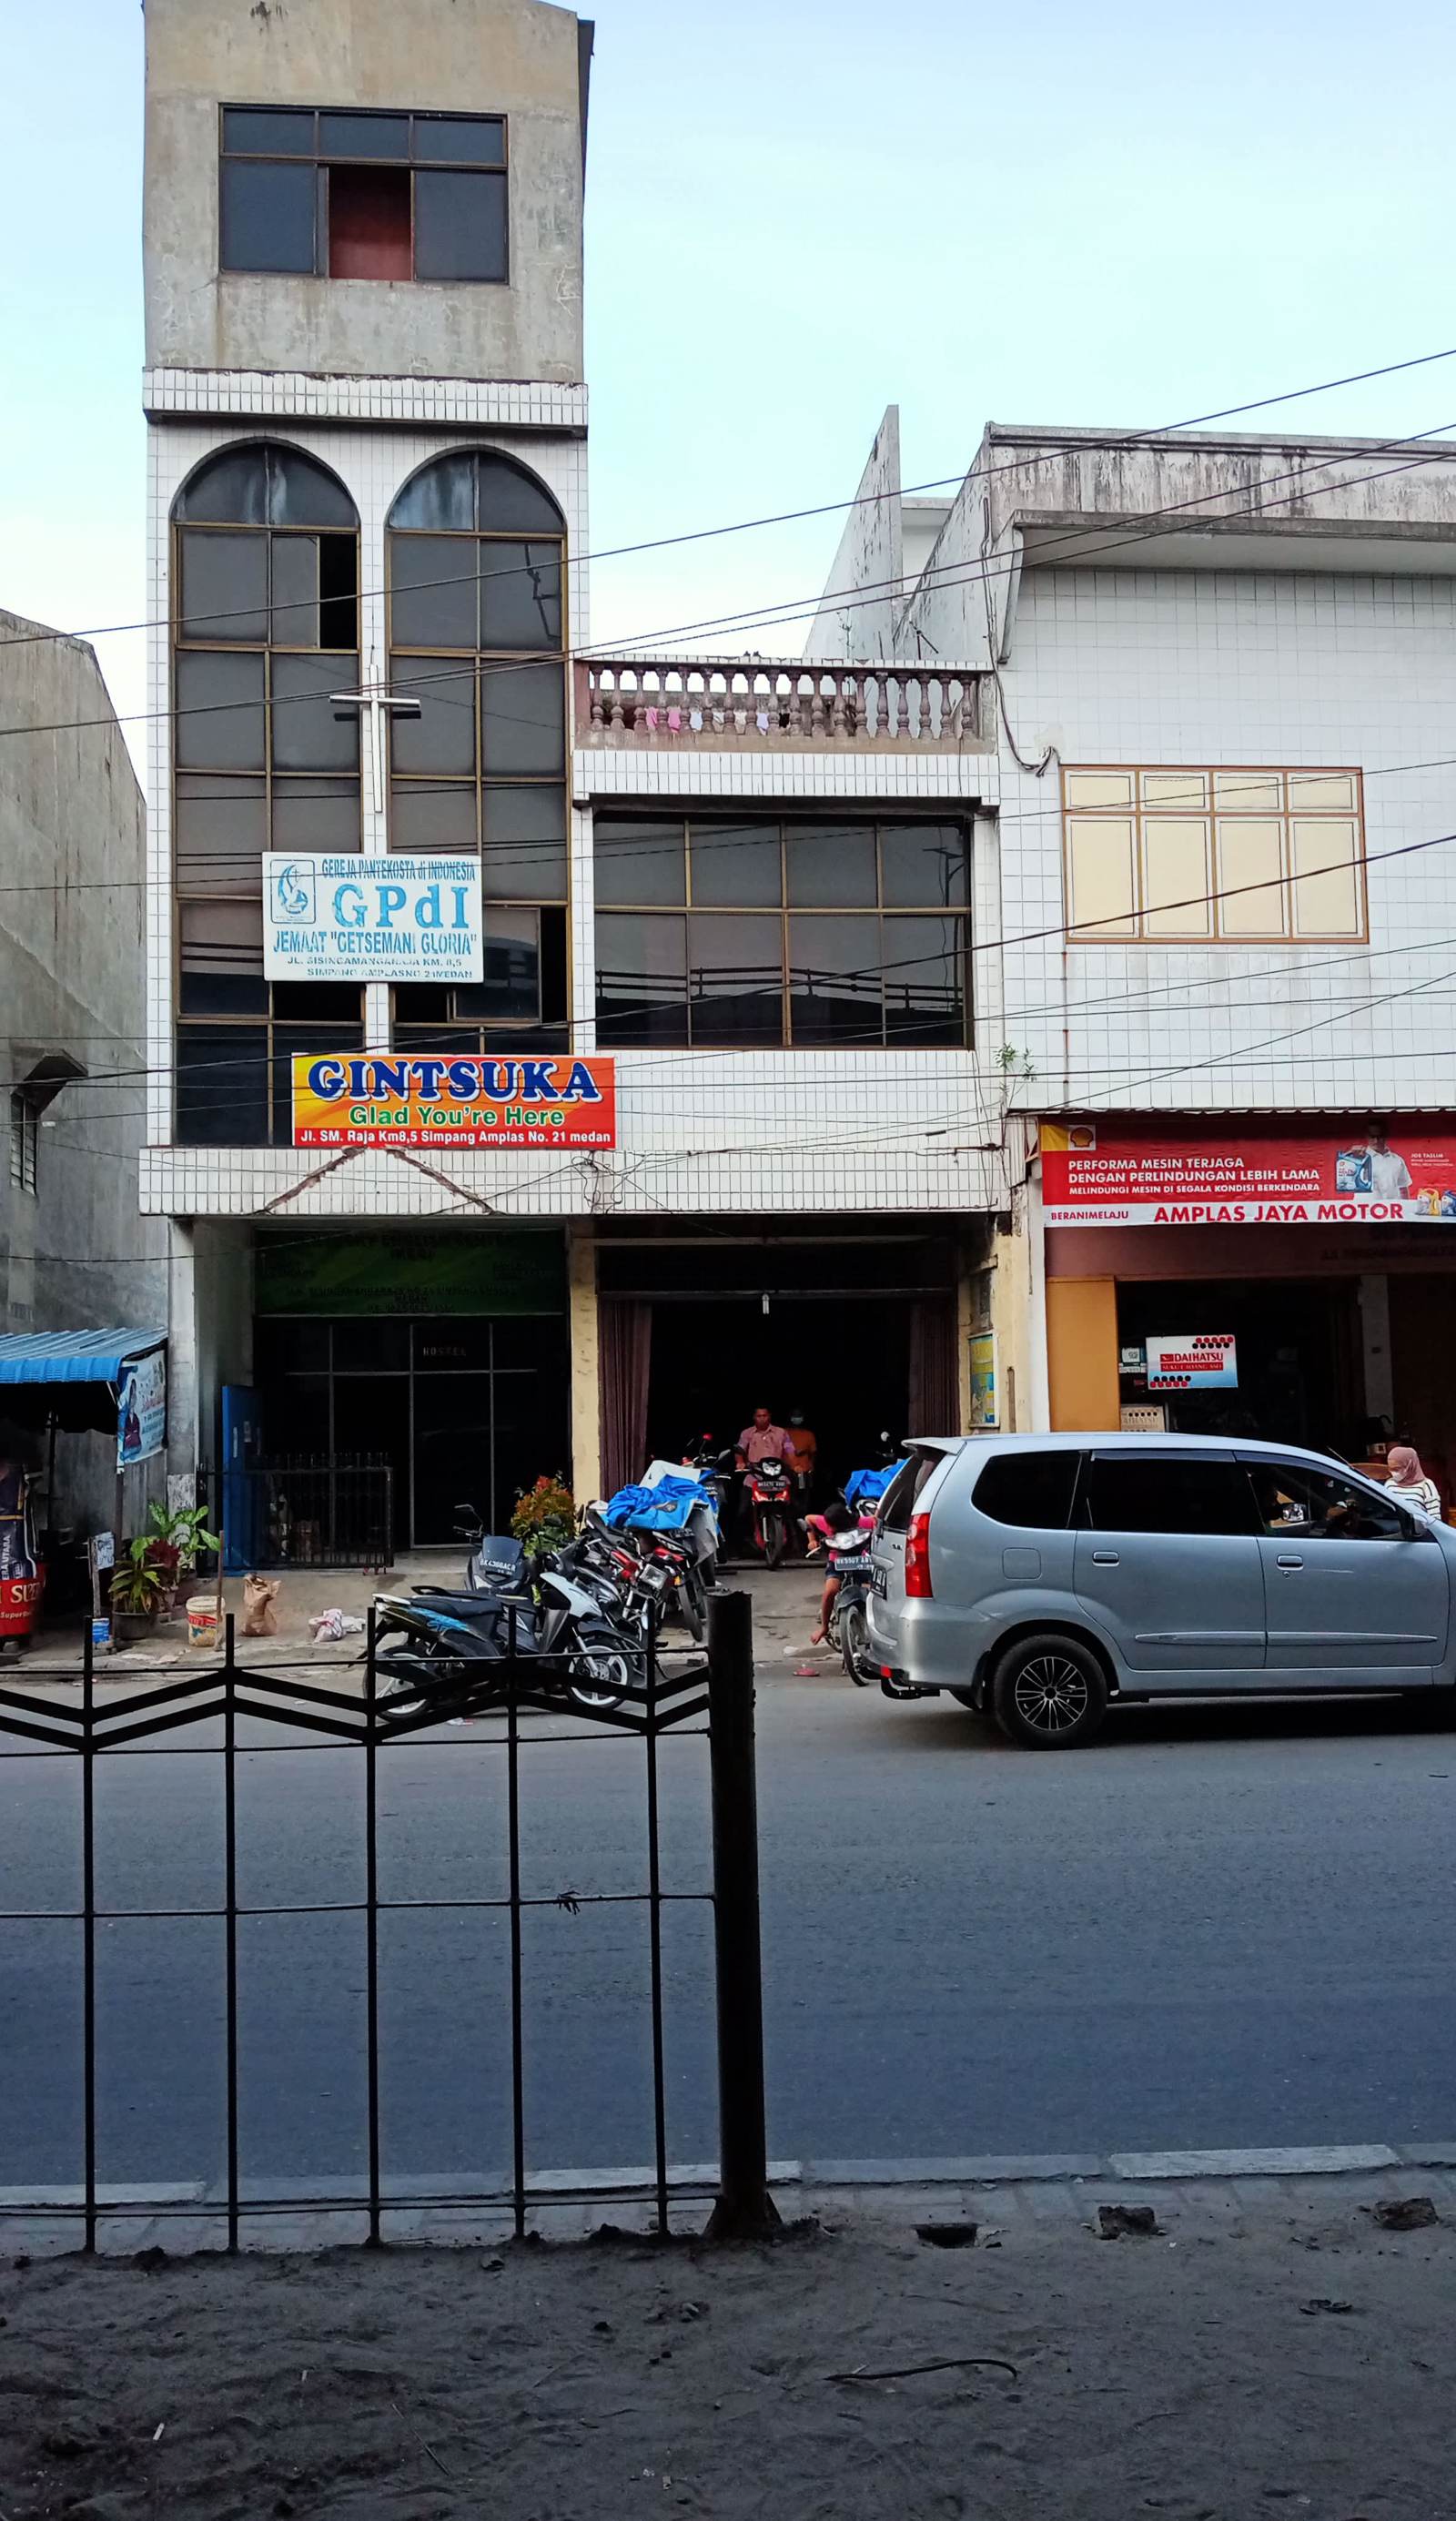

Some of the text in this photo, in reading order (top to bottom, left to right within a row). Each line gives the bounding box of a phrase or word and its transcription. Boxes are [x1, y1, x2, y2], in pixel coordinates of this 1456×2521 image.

[322, 858, 476, 882] GEREJA PANTEKOSTA di INDONESIA
[334, 883, 470, 928] GPdI
[273, 931, 327, 953] JEMAAT
[288, 957, 304, 965] JL.
[308, 1059, 603, 1102] GINTSUKA
[349, 1105, 565, 1126] Glad You're Here
[320, 1129, 343, 1141] SM.
[348, 1130, 376, 1144] Raja
[379, 1130, 418, 1144] Km8,5
[421, 1130, 475, 1144] Simpang
[479, 1130, 524, 1144] Amplas
[528, 1130, 548, 1142] No.
[552, 1130, 566, 1142] 21
[570, 1131, 611, 1143] medan
[1068, 1158, 1245, 1170] PERFORMA MESIN TERJAGA
[1068, 1169, 1320, 1184] DENGAN PERLINDUNGAN LEBIH LAMA
[1069, 1186, 1129, 1195] MELINDUNGI
[1131, 1186, 1161, 1194] MESIN
[1176, 1184, 1212, 1193] SEGALA
[1214, 1184, 1255, 1192] KONDISI
[1257, 1183, 1320, 1192] BERKENDARA
[1050, 1210, 1128, 1220] BERANIMELAJU
[1154, 1203, 1404, 1223] AMPLAS JAYA MOTOR
[1175, 1352, 1223, 1362] DAIHATSU
[2, 1534, 11, 1563] UTARA
